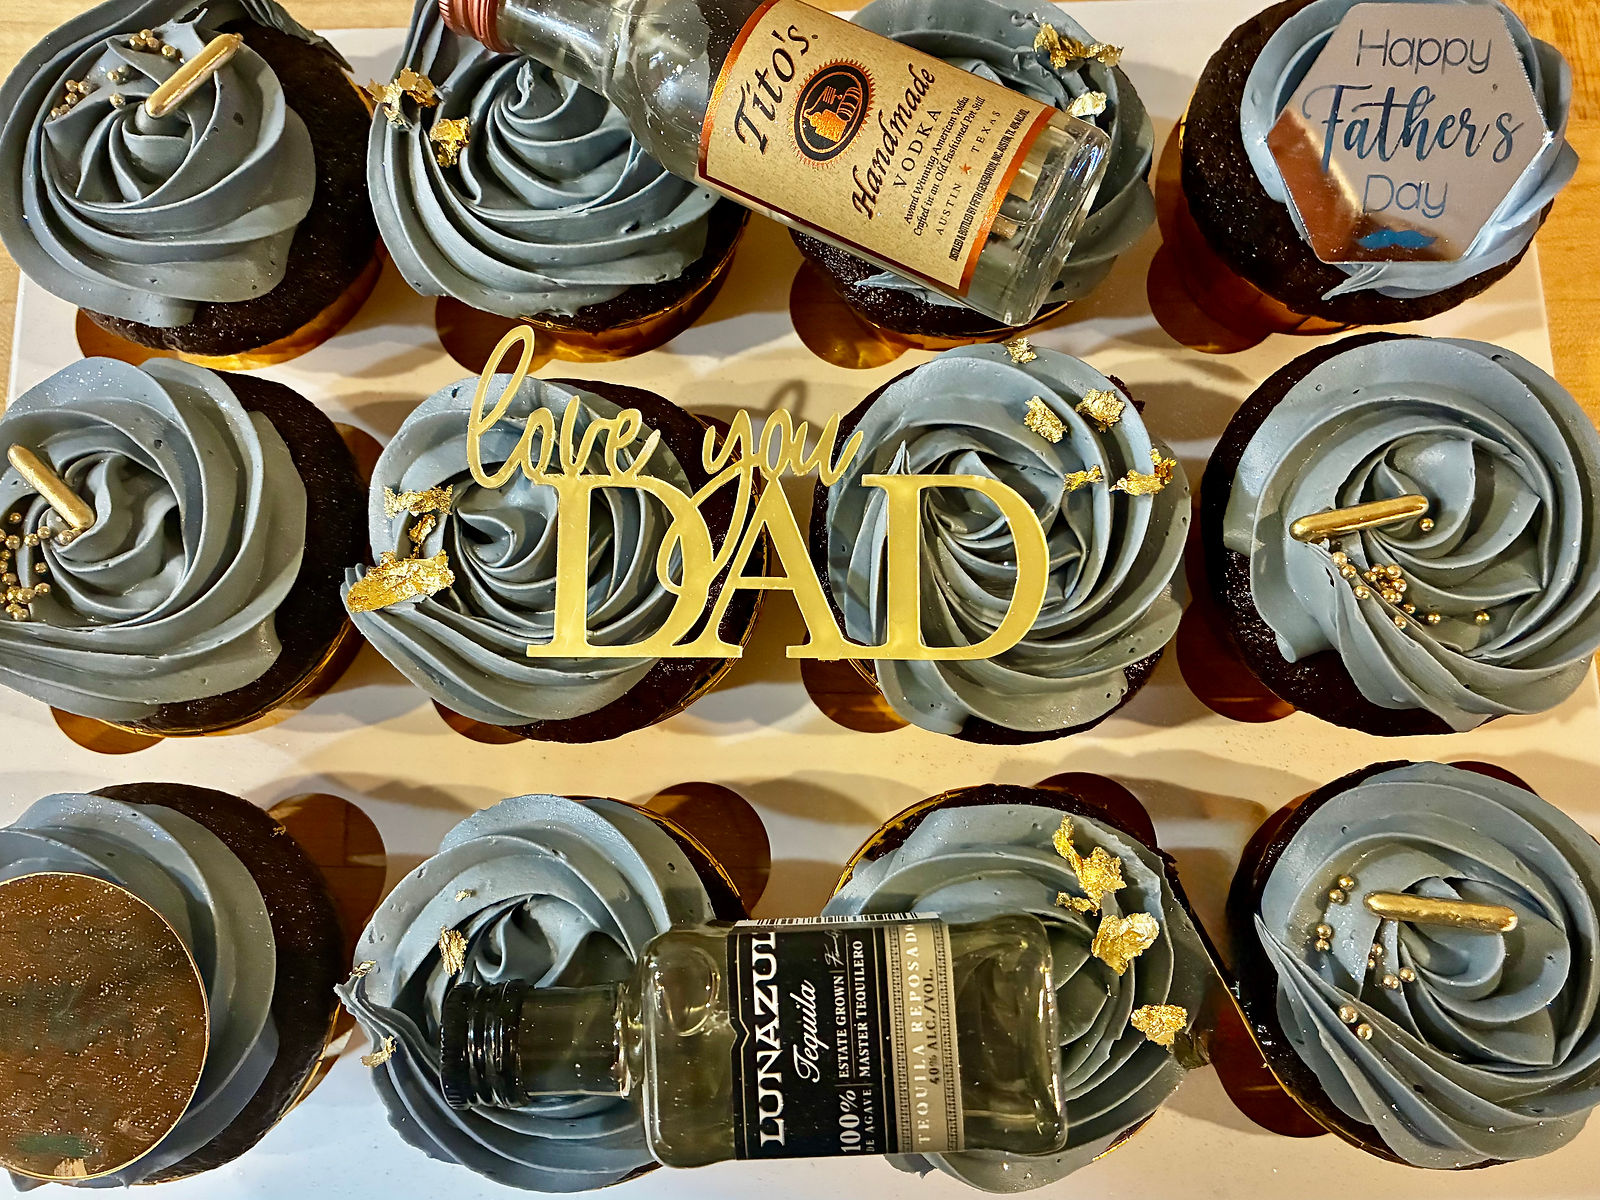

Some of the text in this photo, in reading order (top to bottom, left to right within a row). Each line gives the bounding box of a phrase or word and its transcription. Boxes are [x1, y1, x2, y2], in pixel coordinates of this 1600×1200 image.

[1356, 28, 1492, 75] Happy
[852, 63, 935, 220] Handmade
[893, 109, 942, 188] VODKA
[904, 96, 970, 225] Award Winning American Vodka
[913, 95, 986, 236] Crafted in an Old Fashioned Pot Still
[1302, 84, 1524, 173] Father's
[935, 110, 1001, 236] AUSTIN TEXAS
[968, 190, 983, 208] FIFTH
[975, 160, 1000, 193] GENERATION,
[1362, 174, 1448, 218] Day
[948, 238, 963, 262] DISTILLED
[957, 212, 974, 237] BOTTLED
[466, 324, 661, 489] love
[526, 474, 1050, 661] DAD
[752, 931, 785, 1149] LUNAZUL
[790, 979, 830, 1083] Tequila
[833, 976, 848, 1025] GROWN
[852, 940, 871, 1078] MASTER TEQUILERO
[836, 1027, 849, 1079] ESTATE
[929, 1054, 940, 1086] 40%
[838, 1089, 861, 1152] 100%
[863, 1089, 876, 1152] DE AGAVE
[912, 1044, 931, 1145] TEQUILA
